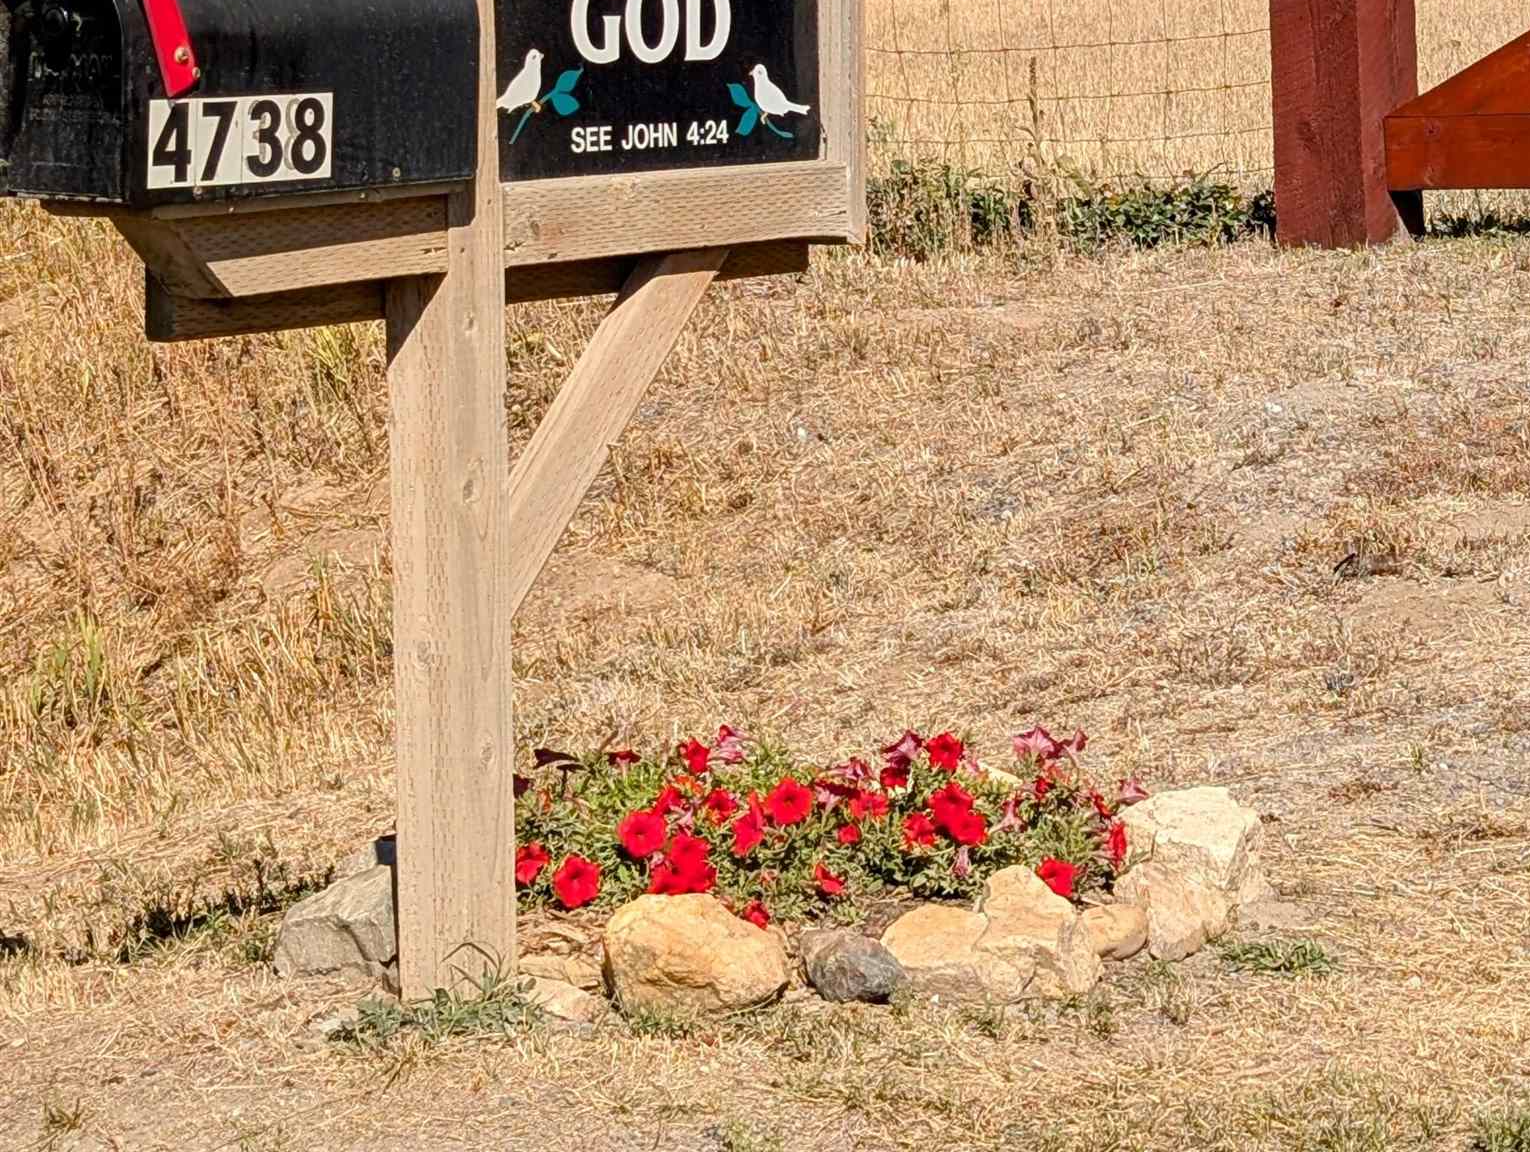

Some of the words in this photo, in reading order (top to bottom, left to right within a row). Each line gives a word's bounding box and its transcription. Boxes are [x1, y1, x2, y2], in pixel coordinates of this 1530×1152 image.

[151, 97, 327, 183] 4738
[570, 125, 613, 154] SEE
[621, 121, 679, 150] JOHN
[686, 119, 730, 146] 4:24
